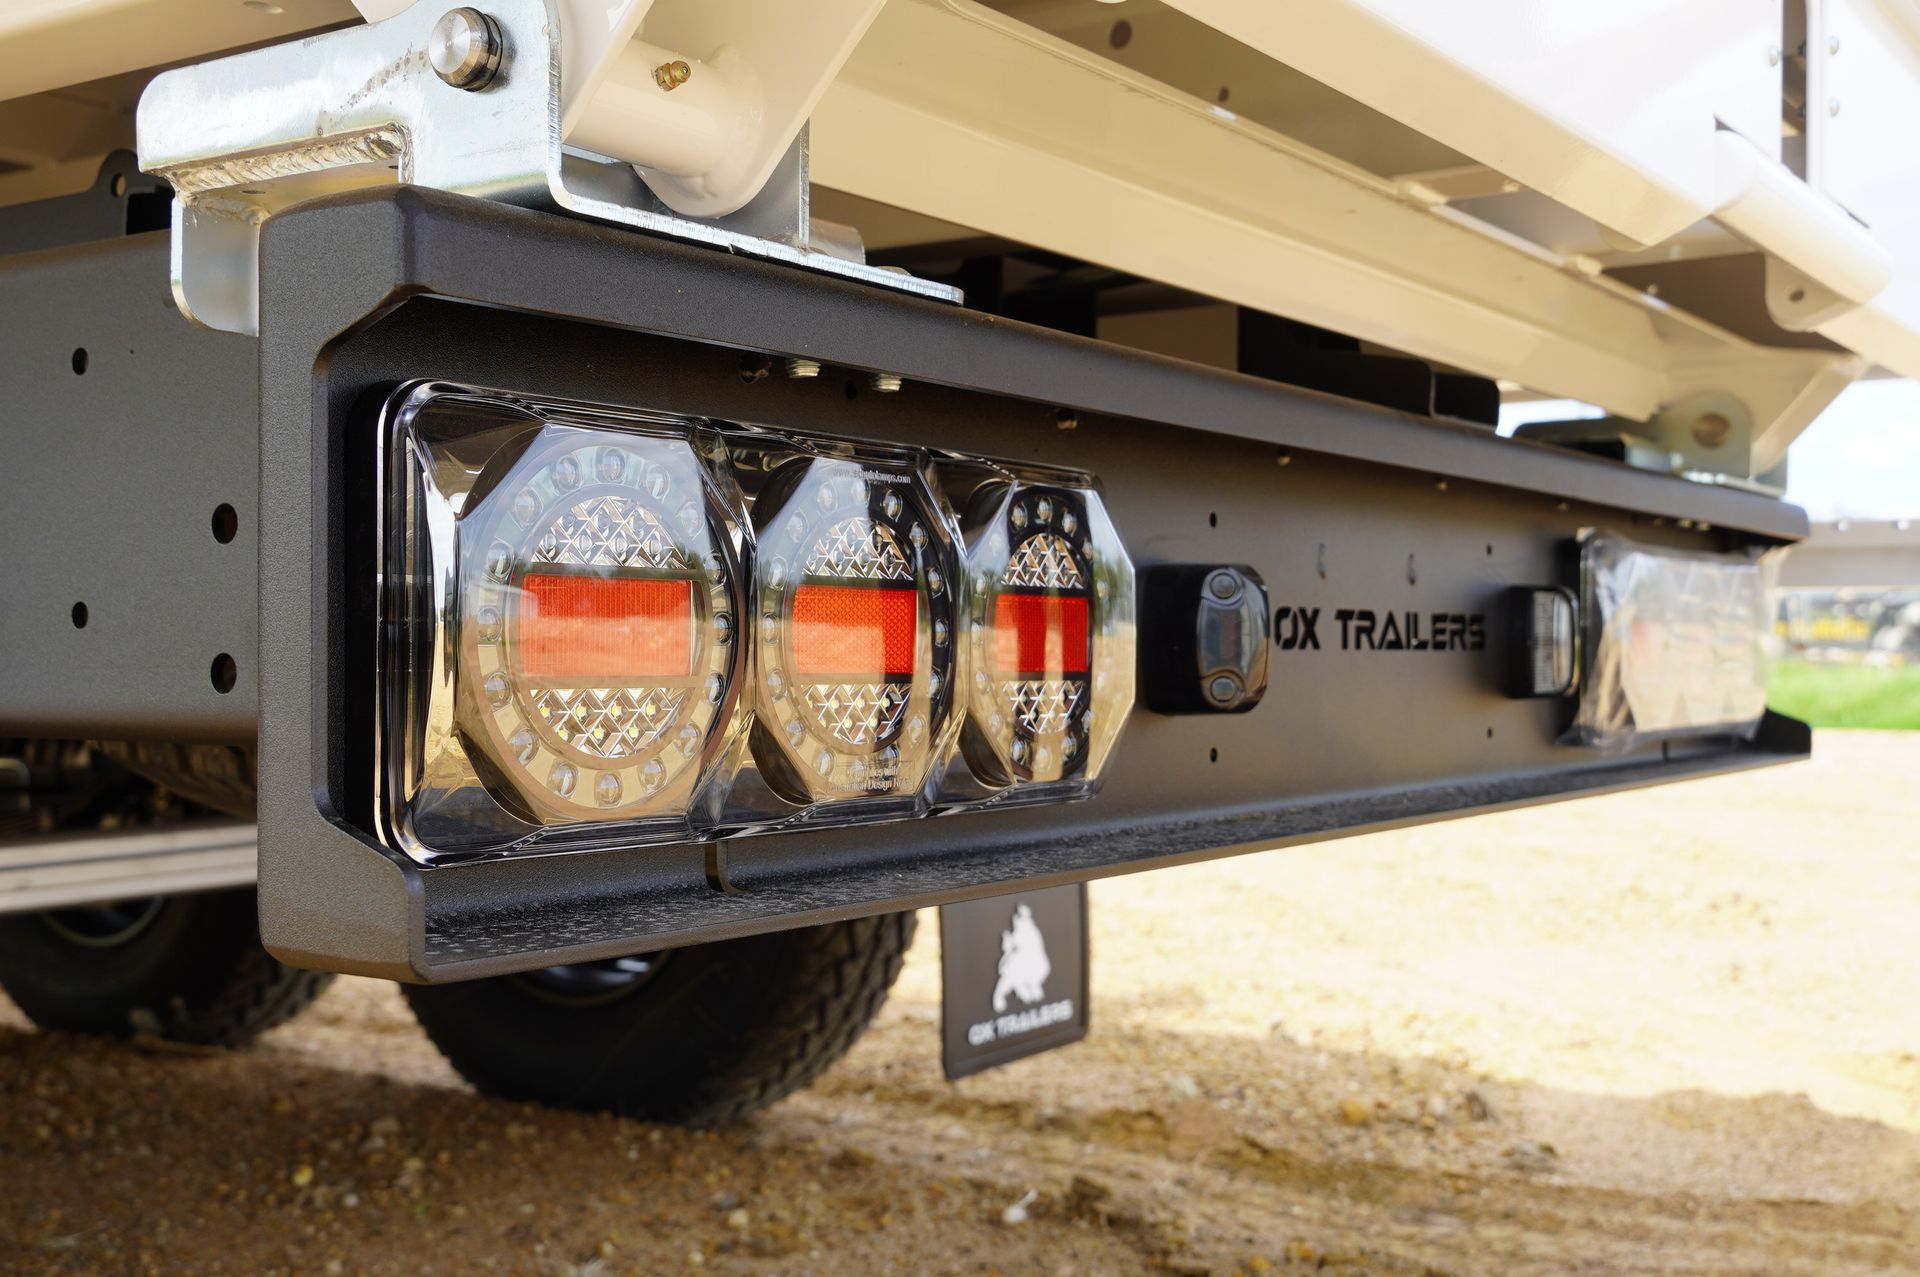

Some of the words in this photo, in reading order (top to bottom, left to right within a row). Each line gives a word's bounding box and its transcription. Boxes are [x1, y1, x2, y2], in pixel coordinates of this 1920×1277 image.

[1274, 606, 1321, 650] OX
[1334, 609, 1486, 650] TRAILERS
[867, 778, 892, 791] Design
[968, 1021, 997, 1046] OX
[998, 999, 1074, 1036] TRAILERS
